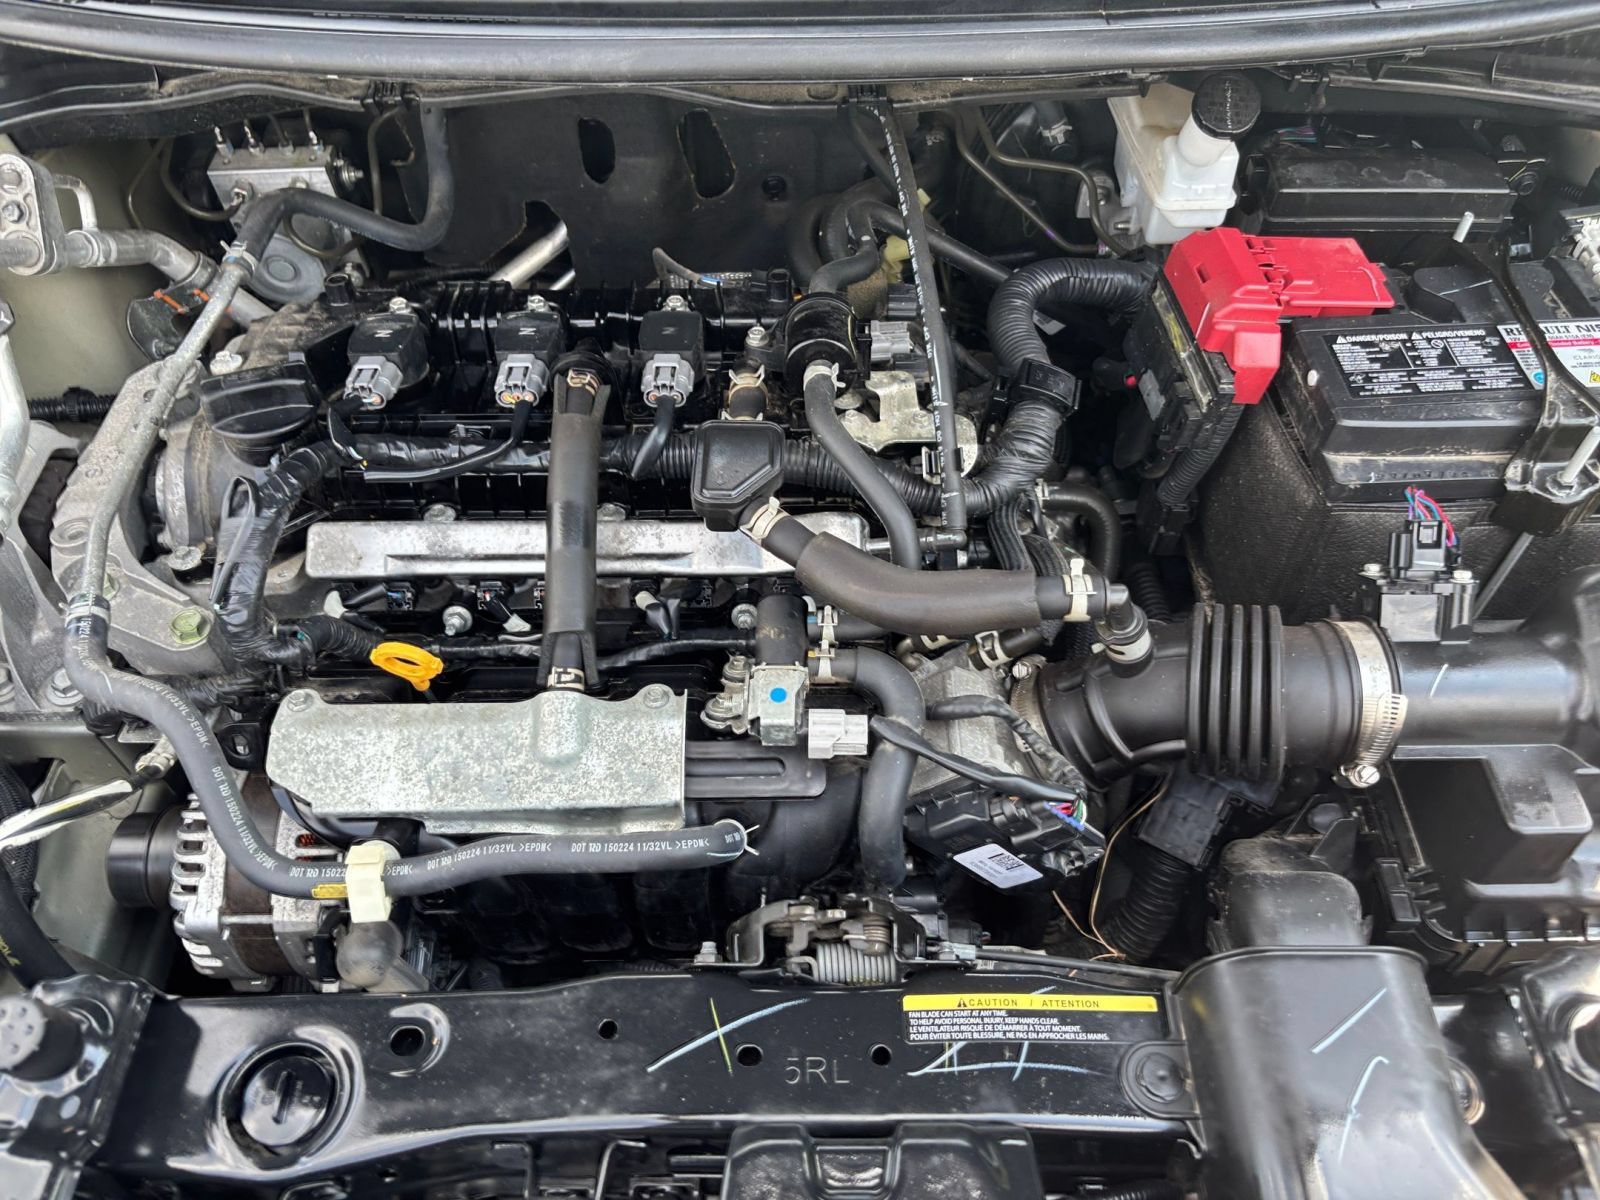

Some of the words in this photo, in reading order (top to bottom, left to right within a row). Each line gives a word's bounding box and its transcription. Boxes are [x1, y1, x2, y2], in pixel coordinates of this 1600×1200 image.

[571, 842, 587, 853] DOT
[604, 841, 635, 853] 150224
[968, 998, 1018, 1007] CAUTION
[1041, 999, 1100, 1008] ATTENTION
[908, 1011, 921, 1019] FAN
[940, 1010, 954, 1018] CAN
[954, 1010, 971, 1018] START
[971, 1010, 979, 1018] AT
[910, 1018, 919, 1026] TO
[919, 1018, 934, 1026] HELP
[934, 1018, 953, 1026] AVOID
[953, 1017, 983, 1025] PERSONAL
[1005, 1017, 1019, 1025] KEEP
[1020, 1017, 1040, 1025] HANDS
[909, 1025, 918, 1033] LE
[918, 1025, 960, 1033] VENTILATEUR
[960, 1025, 983, 1033] RISQUE
[910, 1033, 928, 1041] POUR
[785, 1056, 850, 1084] 5RL
